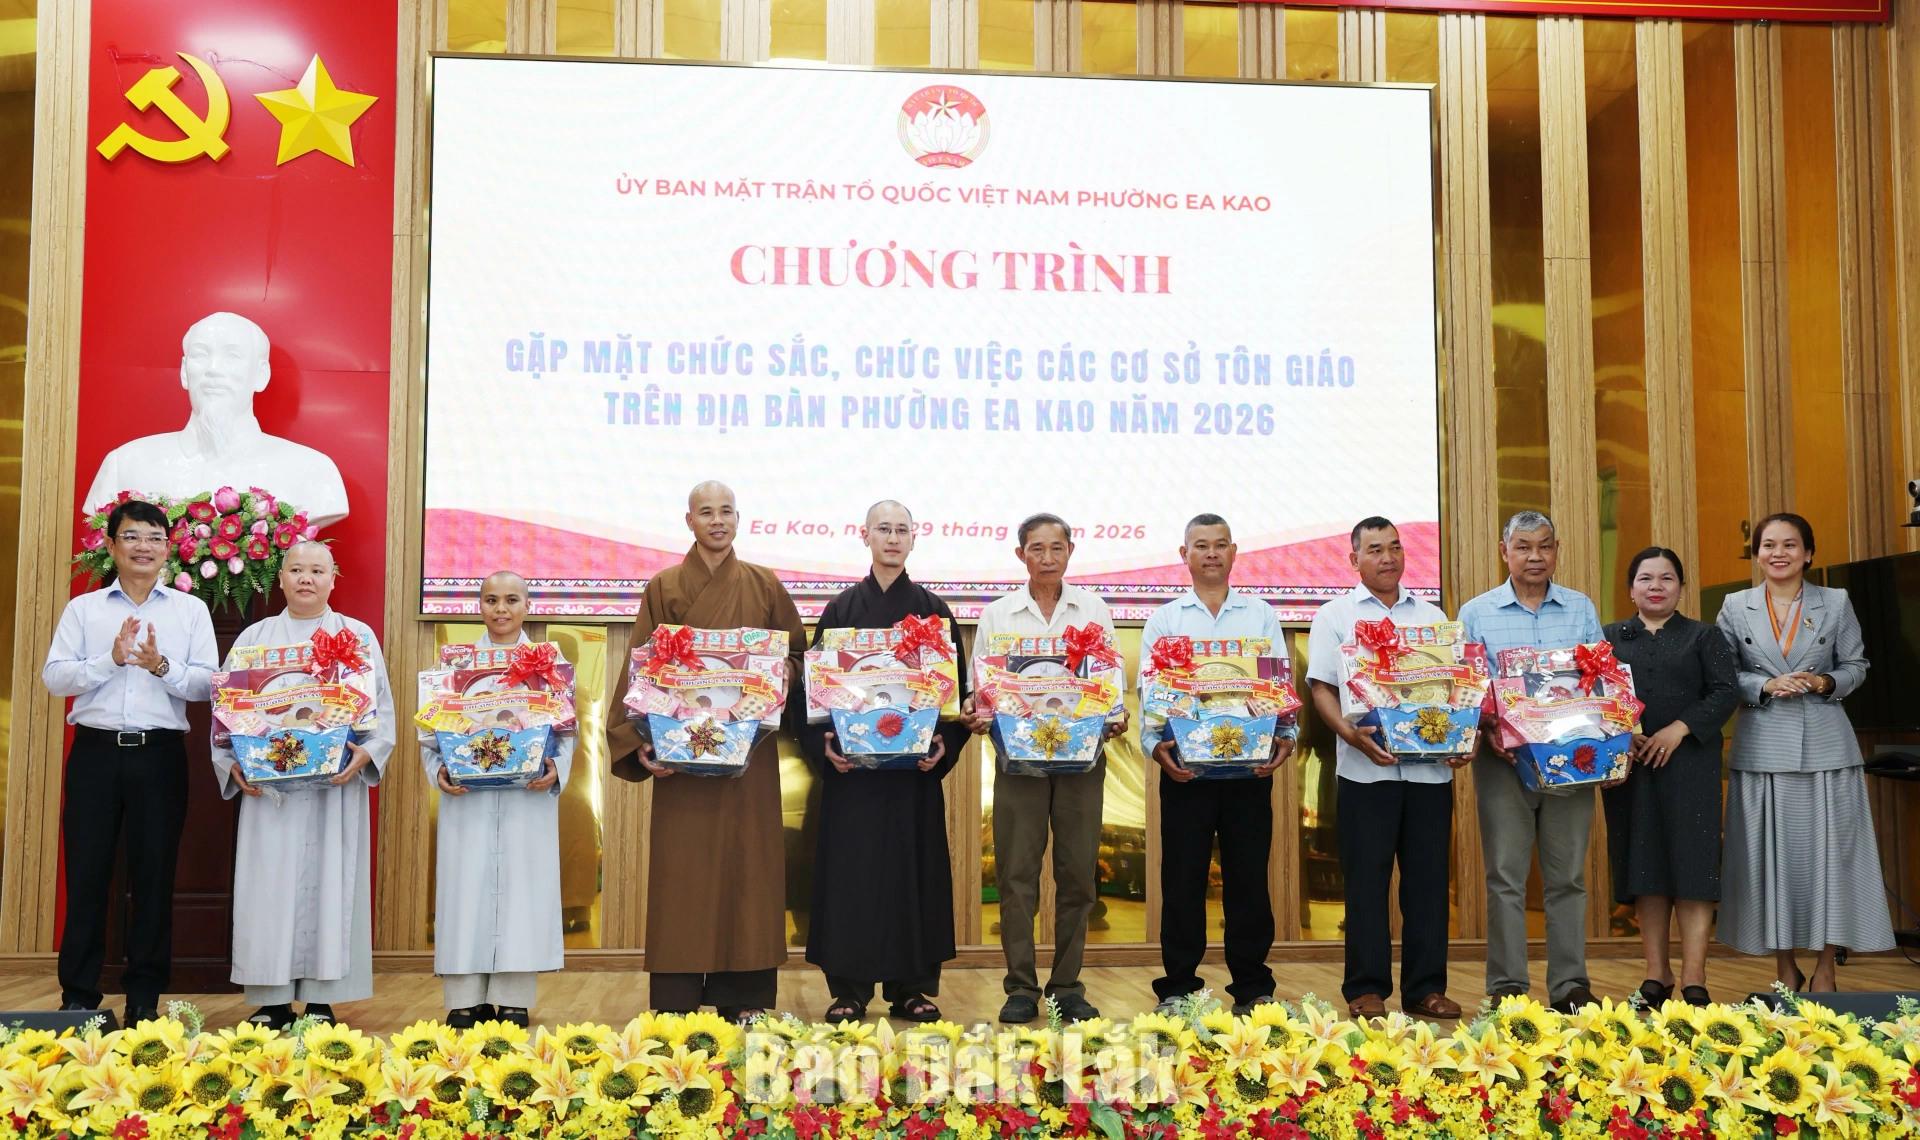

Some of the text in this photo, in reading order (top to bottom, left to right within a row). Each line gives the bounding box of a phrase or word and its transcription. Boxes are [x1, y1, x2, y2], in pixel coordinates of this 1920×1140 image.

[617, 173, 1271, 211] ỦY BAN MẶT TRẬN TỔ QUỐC VIỆT NAM PHƯỜNG EA KAO
[730, 239, 1170, 293] CHƯƠNG TRÌNH
[507, 332, 1354, 387] GẶP MẶT CHỨC SẮC, CHỨC VIỆC CÁC CƠ SỞ TÔN GIÁO
[605, 384, 1274, 435] TRÊN ĐỊA BÀN PHƯỜNG EA KAO NĂM 2026
[750, 520, 777, 534] Ea
[786, 521, 834, 537] Kao,
[942, 522, 1008, 541] tháng
[1094, 525, 1145, 539] 2026
